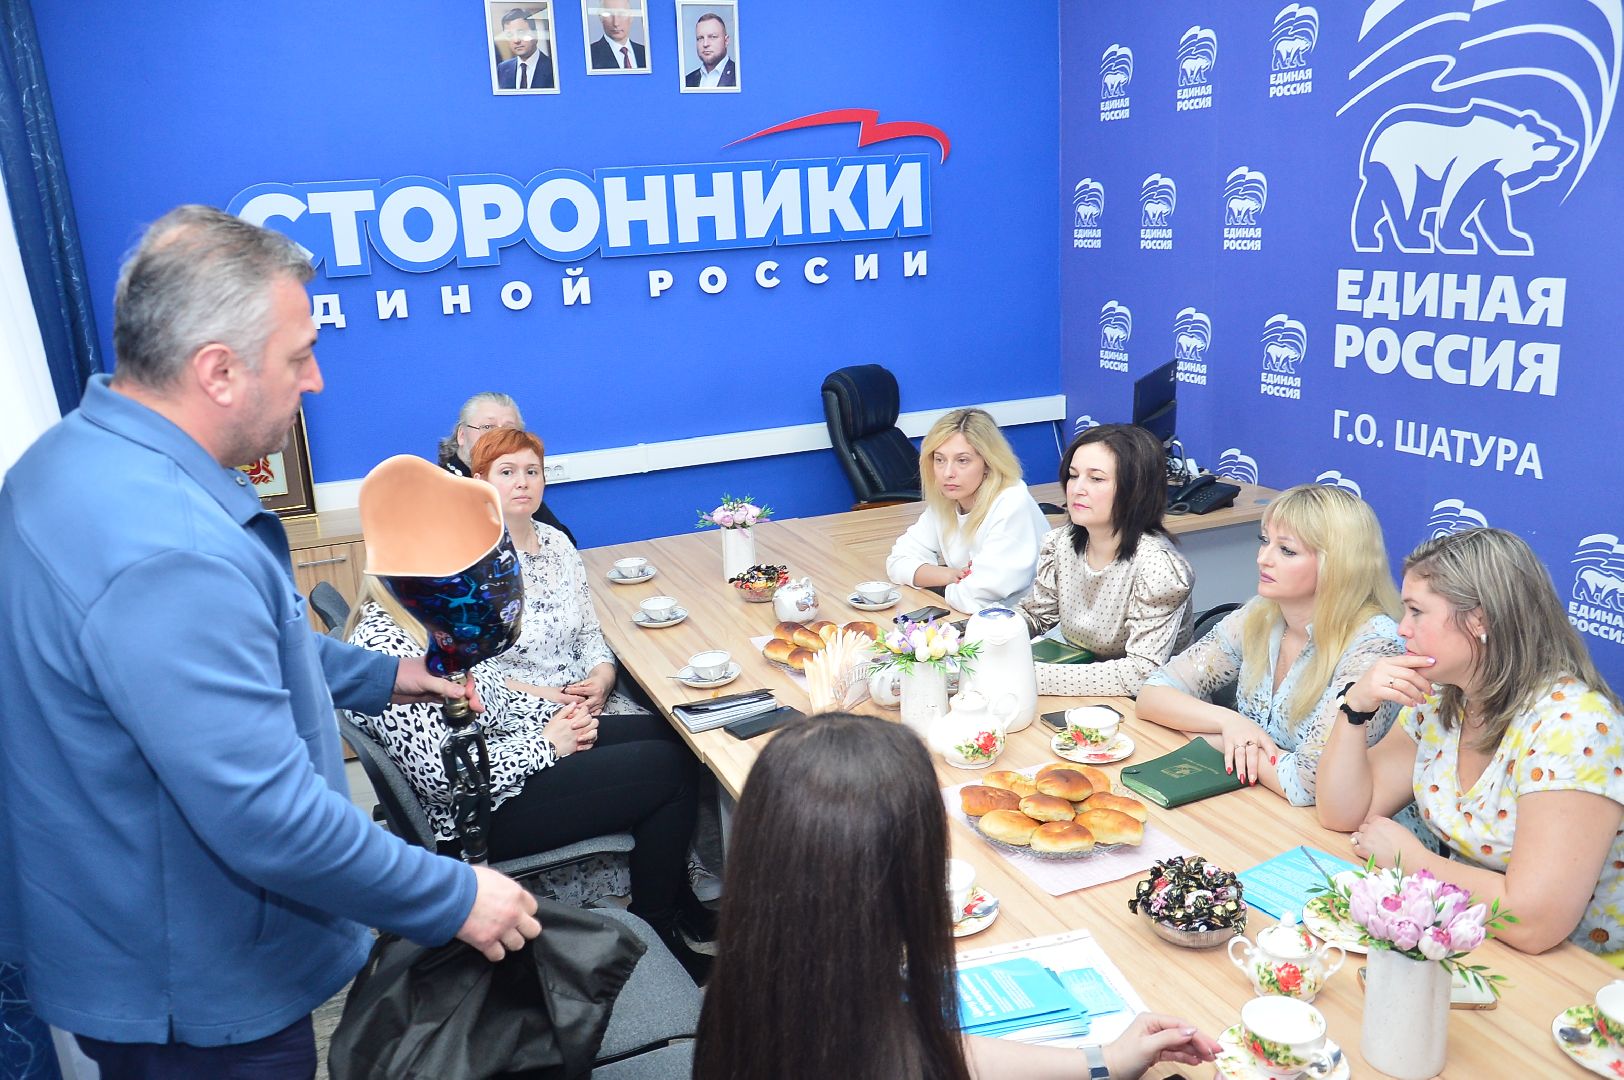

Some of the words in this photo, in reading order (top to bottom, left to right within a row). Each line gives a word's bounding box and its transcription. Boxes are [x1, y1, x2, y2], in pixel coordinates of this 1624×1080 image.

[1269, 69, 1312, 85] ЕДИНАЯ
[1176, 85, 1212, 98] ЕДИНАЯ
[1269, 82, 1311, 97] РОССИЯ
[1100, 97, 1130, 110] ЕДИНАЯ
[1176, 96, 1212, 111] РОССИЯ
[1100, 108, 1130, 122] РОССИЯ
[238, 162, 924, 270] СТОРОННИКИ
[1073, 228, 1102, 239] ЕДИНАЯ
[1140, 228, 1172, 239] ЕДИНАЯ
[1223, 226, 1262, 239] ЕДИНАЯ
[1073, 238, 1101, 249] РОССИЯ
[1140, 238, 1172, 250] РОССИЯ
[1223, 238, 1261, 250] РОССИЯ
[311, 266, 591, 329] ДИНОЙ
[649, 250, 928, 298] РОССИИ
[1336, 268, 1567, 328] ЕДИНАЯ
[1100, 350, 1129, 362] ЕДИНАЯ
[1334, 324, 1561, 396] РОССИЯ
[1100, 361, 1128, 372] РОССИЯ
[1176, 361, 1207, 374] ДИНАЯ
[1260, 372, 1301, 387] ЕДИНАЯ
[1260, 385, 1301, 399] РОССИЯ
[1333, 409, 1384, 448] Г.О.
[1395, 419, 1543, 480] ШАТУРА
[1568, 601, 1624, 628] ЕДИНА
[1568, 615, 1624, 645] РОССИ
